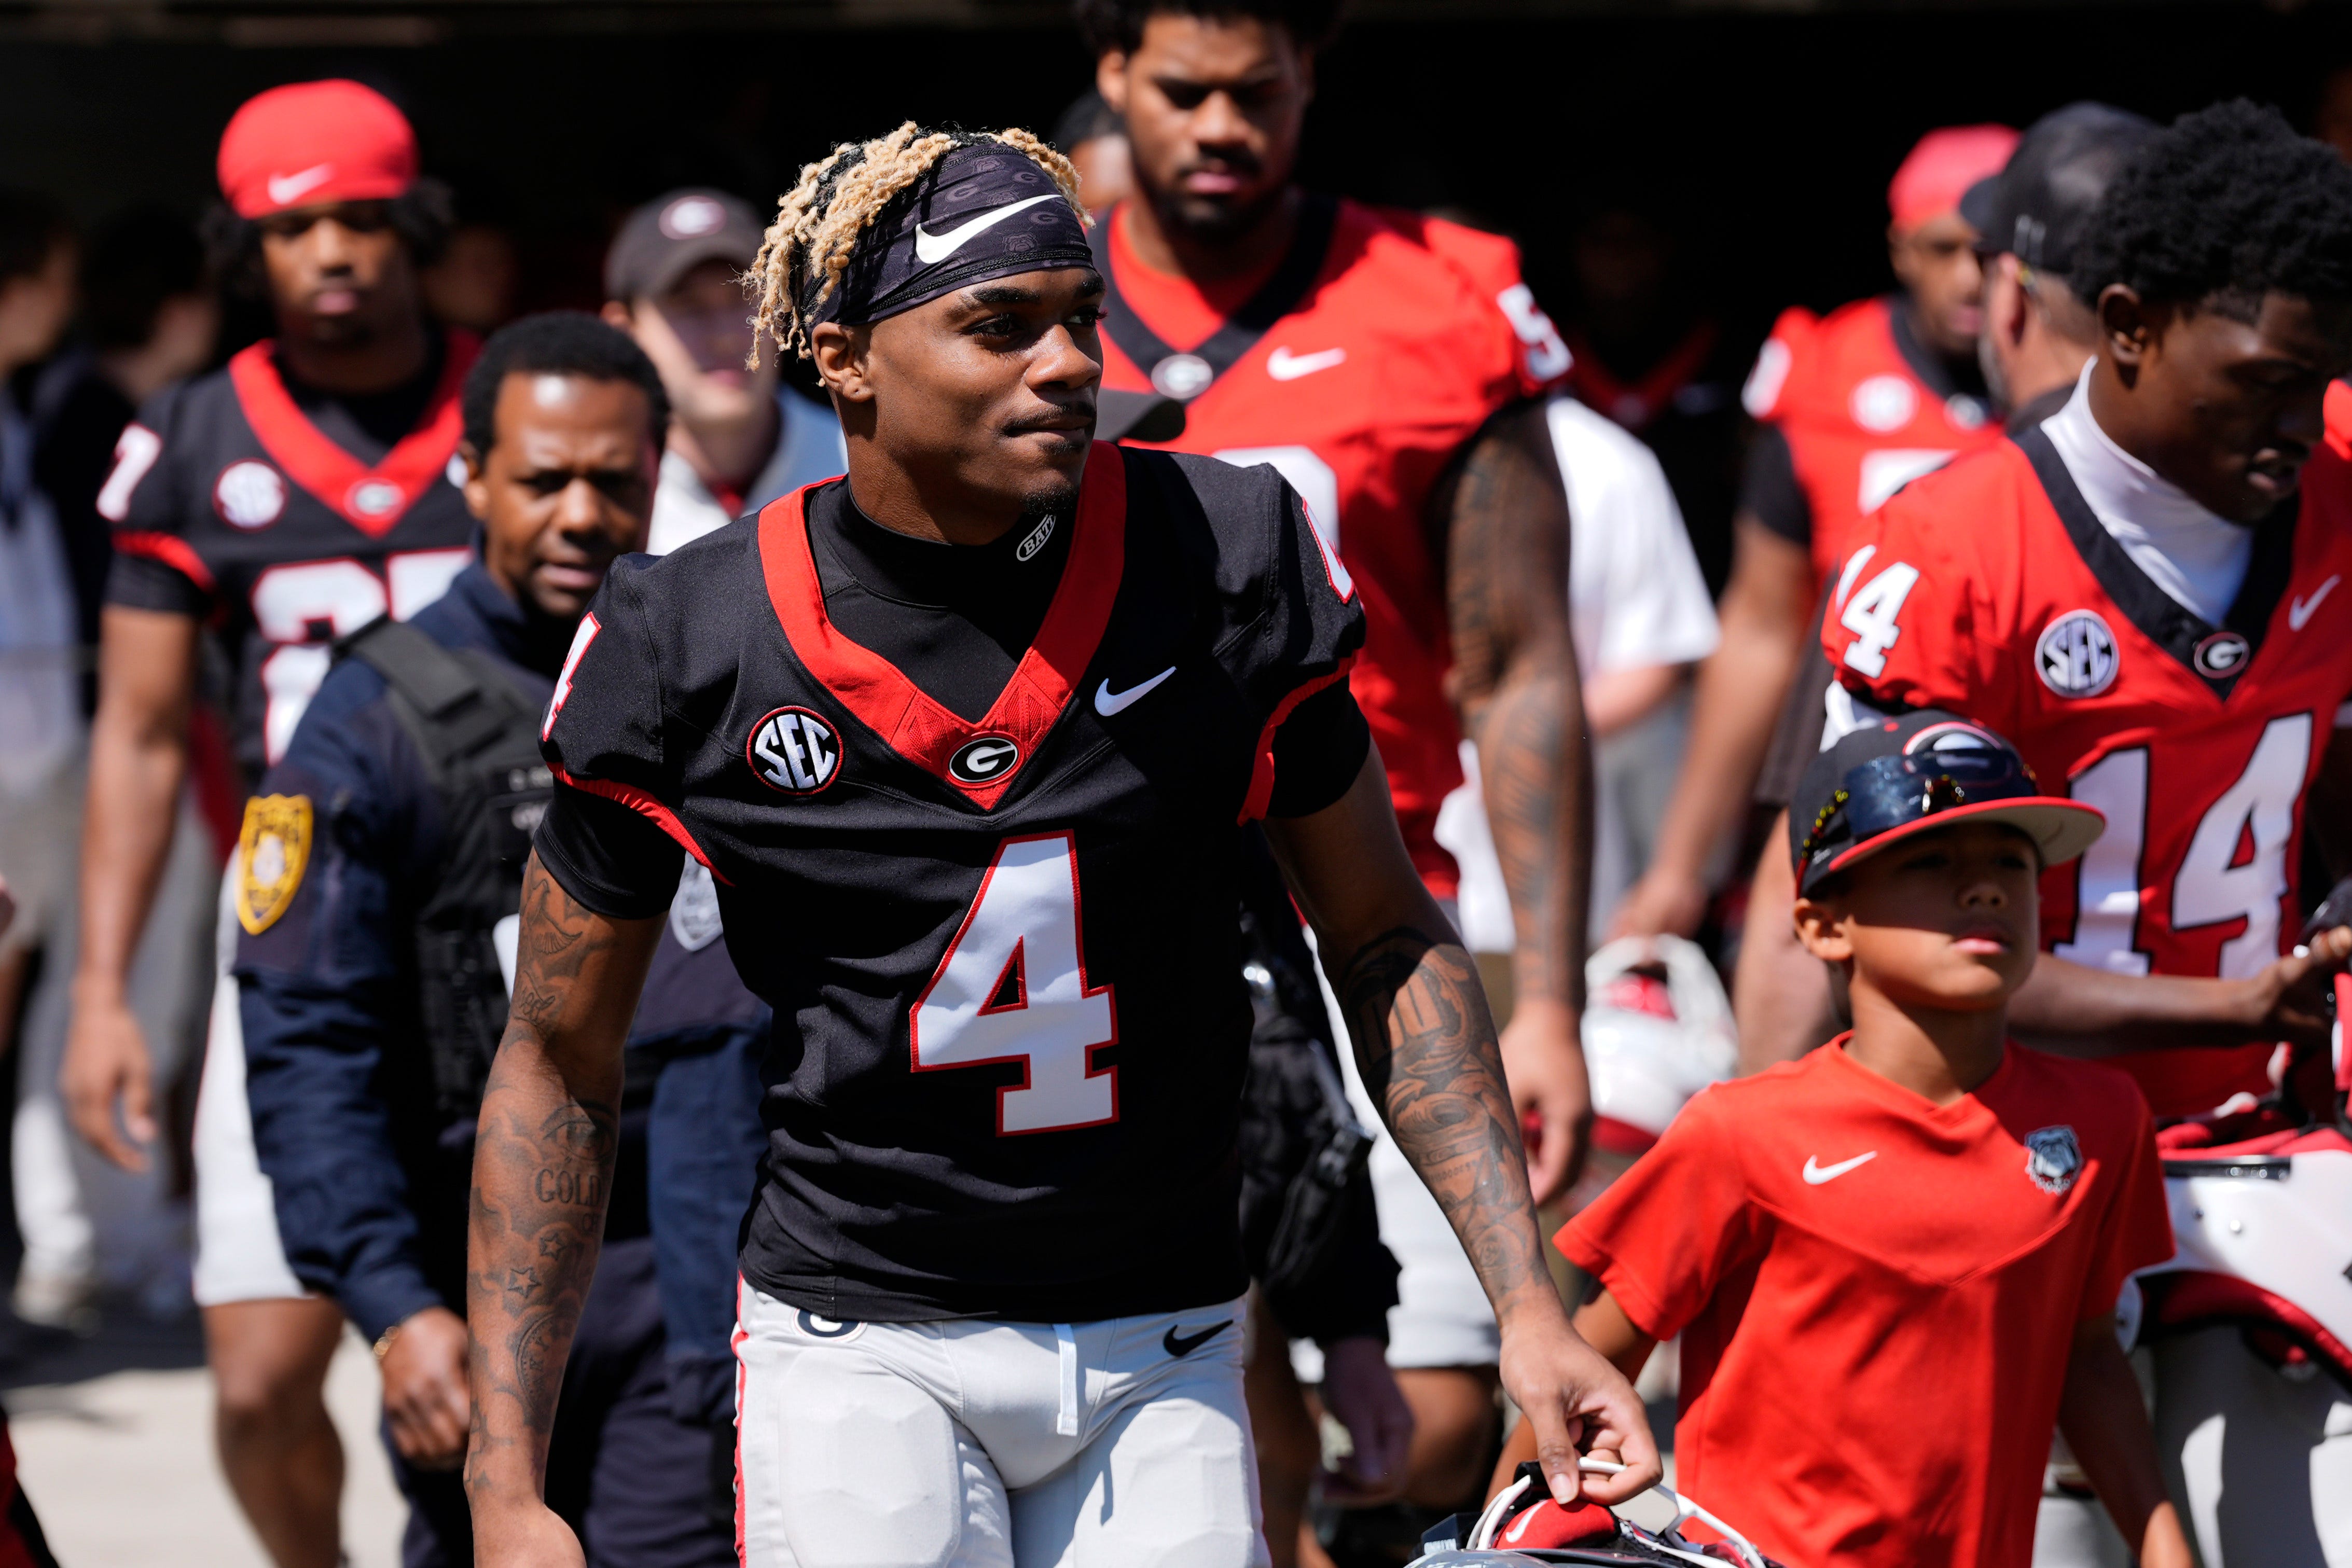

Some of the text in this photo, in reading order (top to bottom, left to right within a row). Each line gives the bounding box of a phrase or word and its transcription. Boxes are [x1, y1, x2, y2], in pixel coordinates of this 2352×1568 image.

[2044, 618, 2112, 690] SEC
[755, 714, 836, 789] SEC
[2051, 711, 2314, 980] 14
[910, 829, 1119, 1137] 4
[535, 1168, 602, 1208] GOLD
